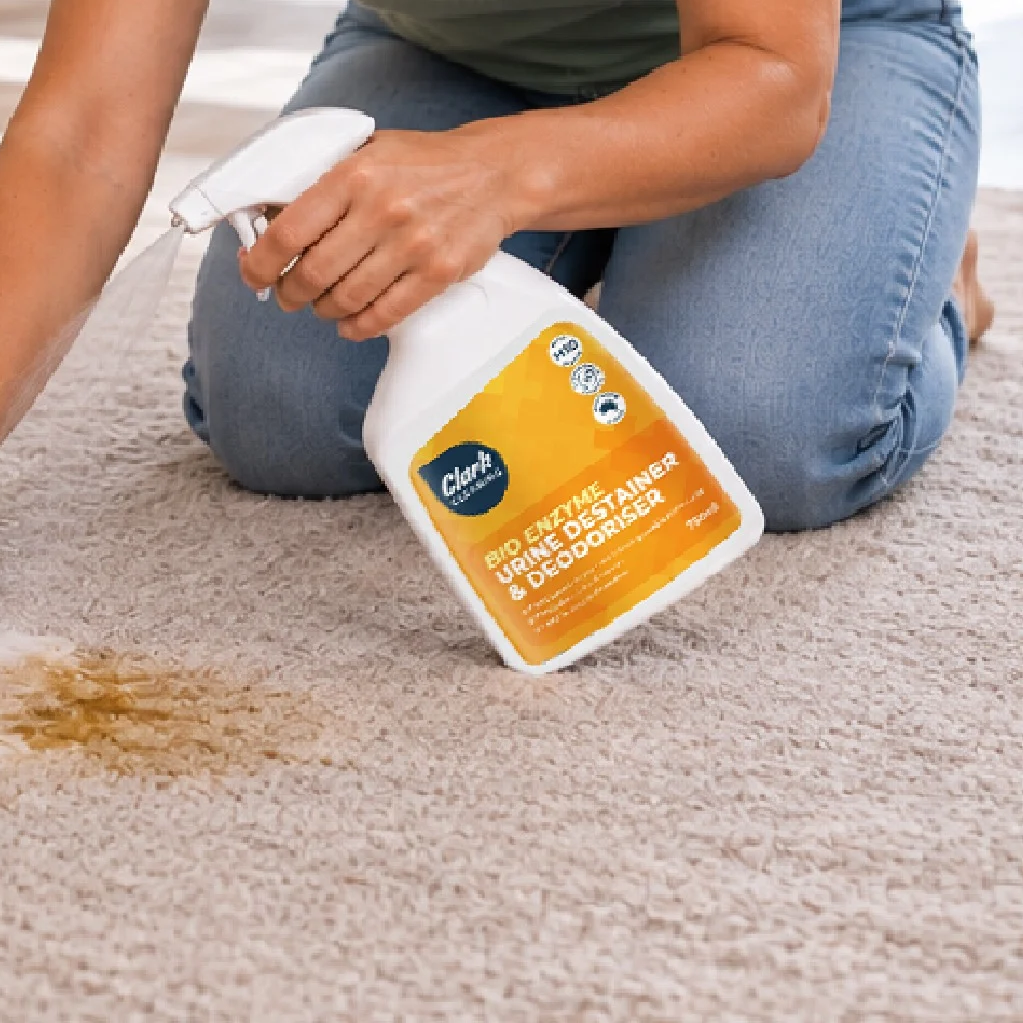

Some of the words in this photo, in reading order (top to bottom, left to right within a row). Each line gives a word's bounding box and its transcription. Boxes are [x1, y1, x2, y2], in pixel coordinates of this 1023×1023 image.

[442, 450, 492, 496] Clark
[495, 532, 564, 584] URINE
[562, 451, 680, 540] DESTAINER
[484, 538, 522, 570] BIO
[523, 480, 605, 544] ENZYME
[509, 584, 527, 601] &
[526, 488, 666, 589] DEODORISER
